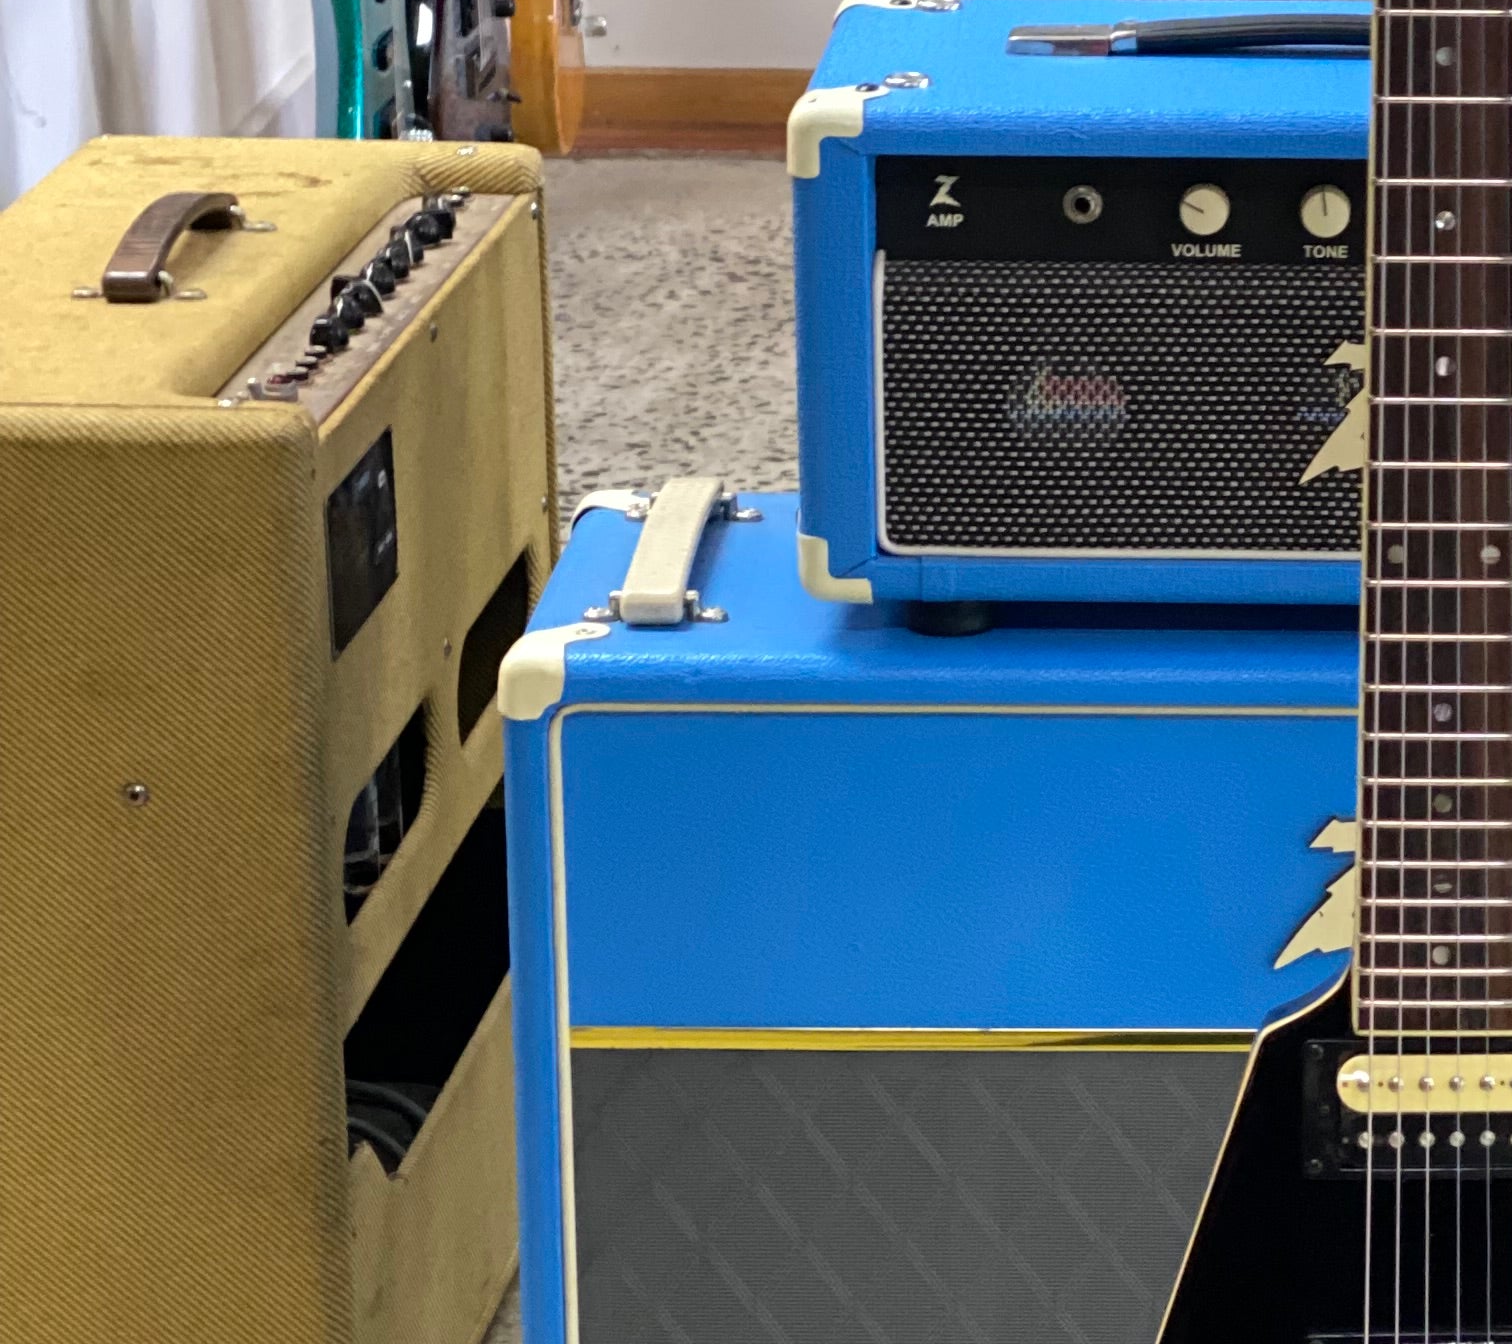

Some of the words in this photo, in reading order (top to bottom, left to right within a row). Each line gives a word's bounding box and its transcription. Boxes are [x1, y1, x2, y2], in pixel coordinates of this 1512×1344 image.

[926, 213, 964, 228] AMP
[1171, 243, 1242, 258] VOLUME
[1303, 244, 1350, 259] TONE
